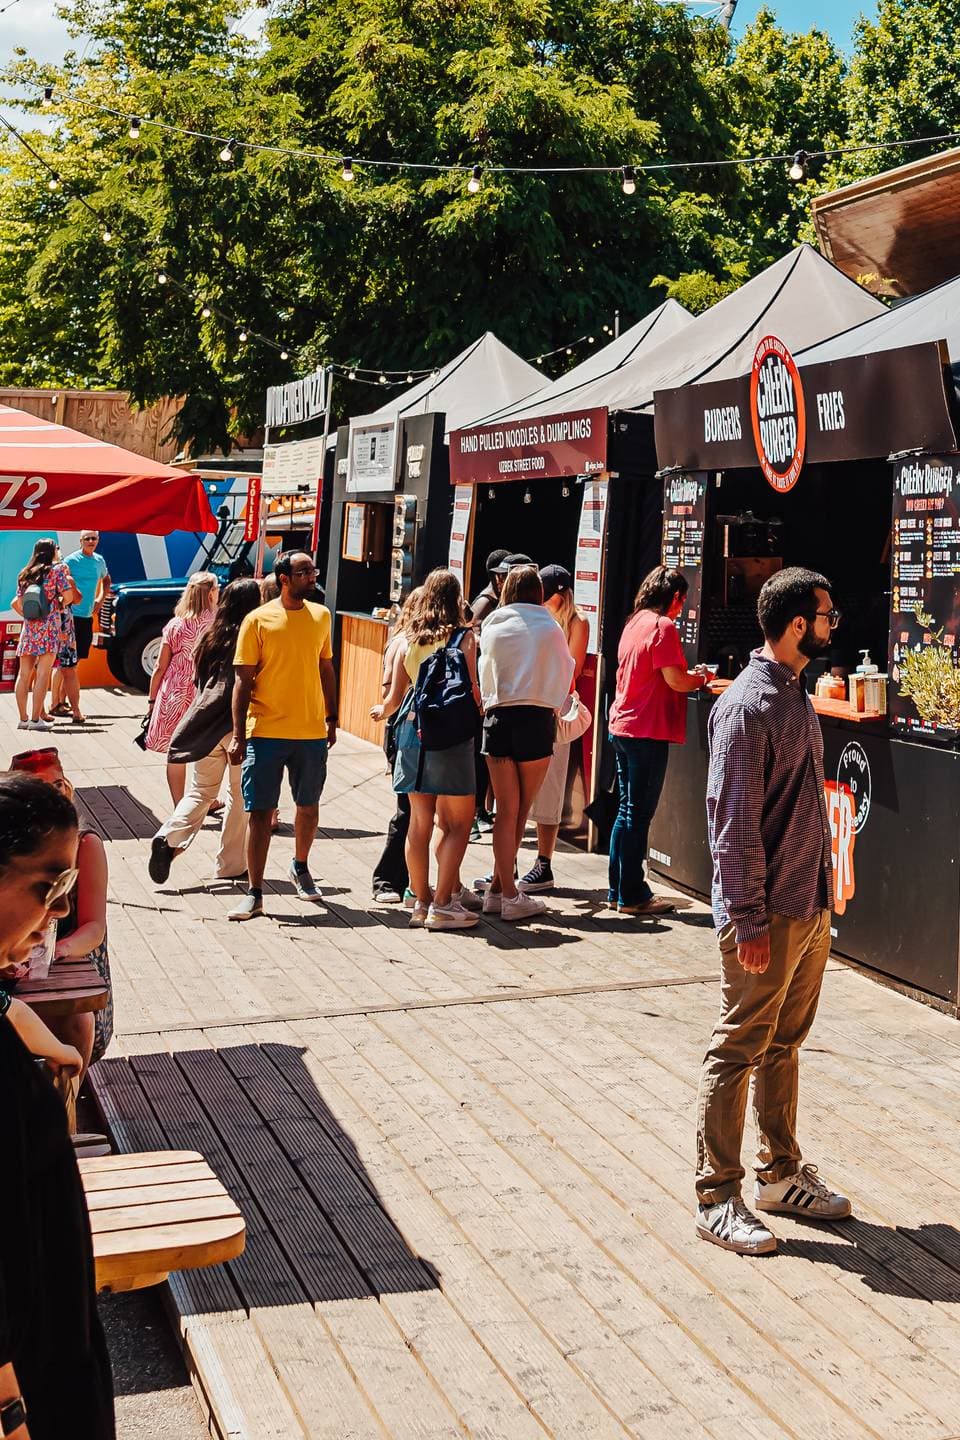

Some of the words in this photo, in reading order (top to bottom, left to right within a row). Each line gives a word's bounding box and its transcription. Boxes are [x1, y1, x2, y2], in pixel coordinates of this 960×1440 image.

[757, 357, 794, 419] CHEEKY
[703, 405, 742, 443] BURGERS
[816, 390, 846, 432] FRIES
[460, 434, 479, 453] HAND
[479, 431, 504, 451] PULLED
[505, 425, 539, 448] NOODLES
[540, 426, 545, 443] &
[547, 418, 592, 442] DUMPLINGS
[759, 416, 797, 464] BURGER
[514, 458, 531, 472] STREET
[531, 456, 545, 470] FOOD
[248, 480, 256, 538] COLLECT
